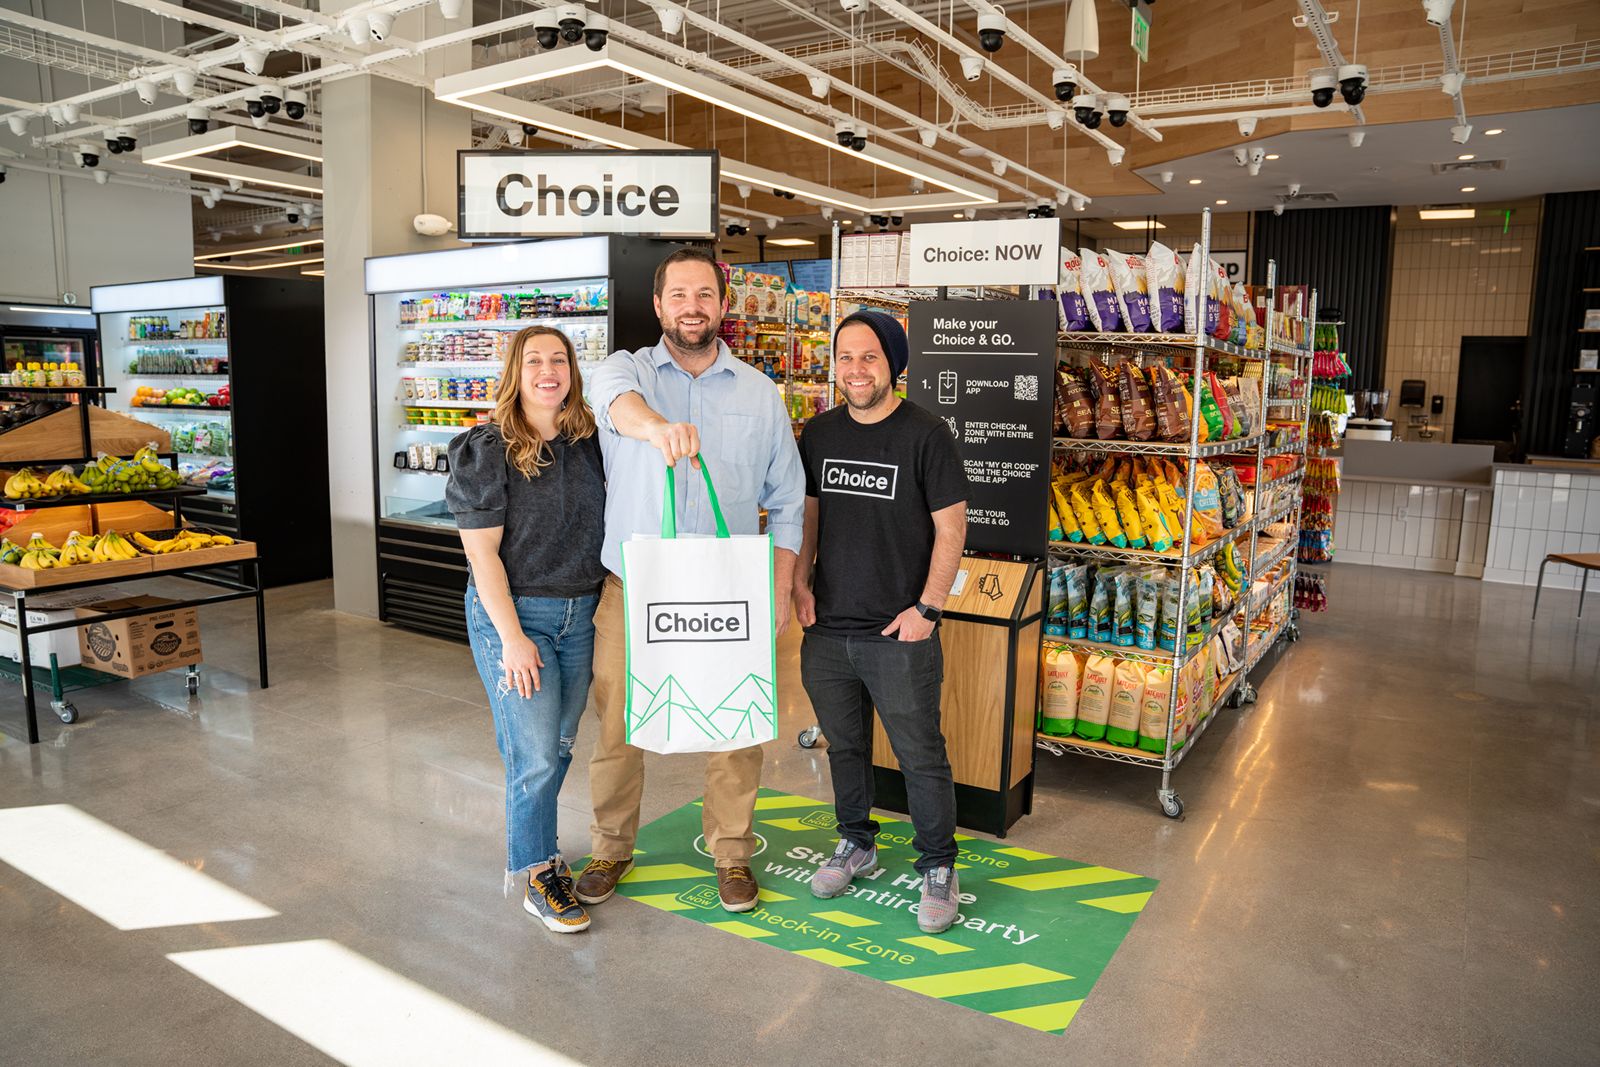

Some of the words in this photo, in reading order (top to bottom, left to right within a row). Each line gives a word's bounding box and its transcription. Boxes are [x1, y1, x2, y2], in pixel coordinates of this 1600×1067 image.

[496, 173, 680, 217] Choice
[923, 247, 989, 262] Choice:
[995, 244, 1043, 261] NOW
[933, 318, 967, 330] Make
[970, 320, 998, 332] your
[933, 334, 976, 346] Choice
[979, 334, 988, 346] &
[991, 334, 1015, 346] GO.
[921, 378, 932, 390] 1.
[966, 379, 1010, 388] DOWNLOAD
[965, 421, 989, 430] ENTER
[990, 422, 1028, 431] CHECK-IN
[986, 430, 1005, 438] WITH
[1006, 431, 1034, 439] ENTIRE
[963, 459, 984, 467] SCAN
[1001, 461, 1013, 470] QR
[827, 467, 888, 490] Choice
[986, 468, 1001, 477] THE
[1002, 470, 1031, 478] CHOICE
[985, 510, 1006, 518] YOUR
[966, 516, 990, 524] HOICE
[998, 518, 1010, 526] GO
[655, 612, 740, 633] Choice
[892, 873, 977, 904] He
[686, 895, 712, 906] NOW
[847, 936, 917, 966] Zone
